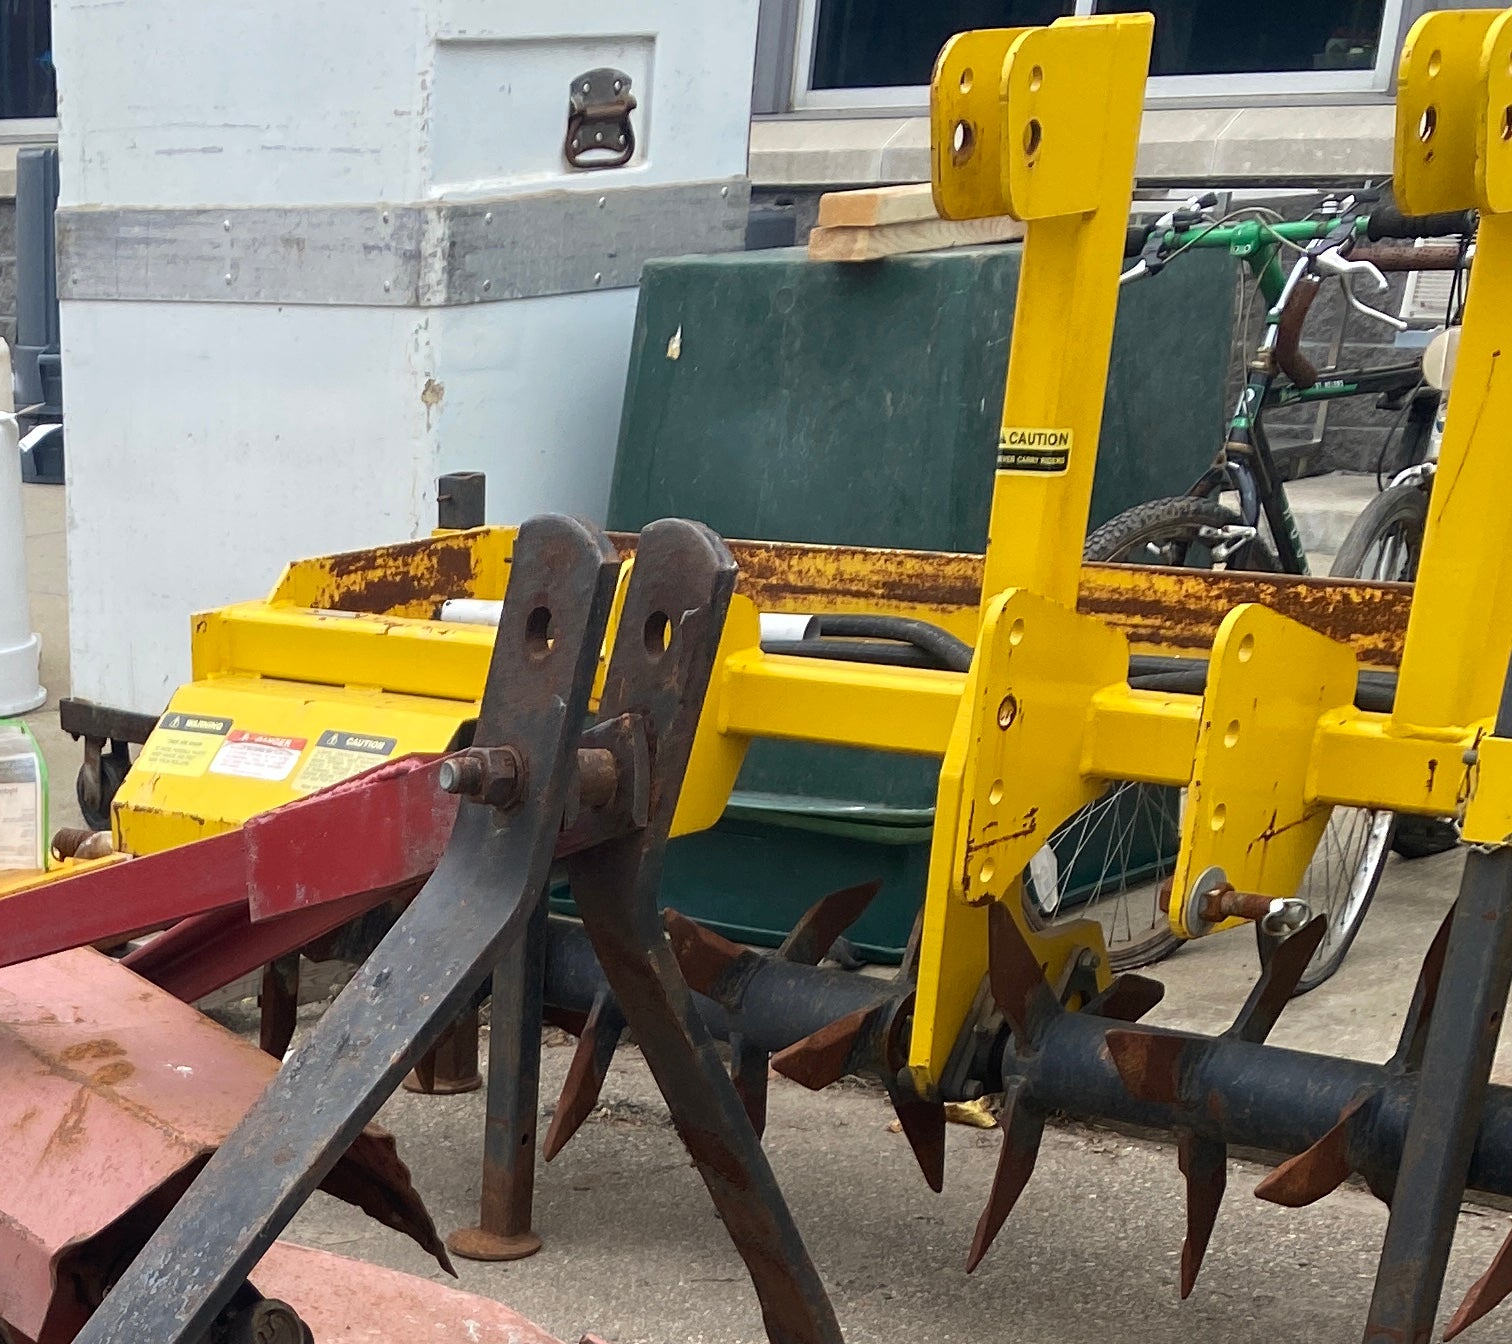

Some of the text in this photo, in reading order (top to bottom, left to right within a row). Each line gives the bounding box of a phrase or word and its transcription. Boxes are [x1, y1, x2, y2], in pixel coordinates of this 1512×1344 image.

[1009, 431, 1068, 446] CAUTION
[185, 718, 224, 731] WARNING
[254, 735, 293, 748] DANGER
[345, 736, 386, 750] CAUTION
